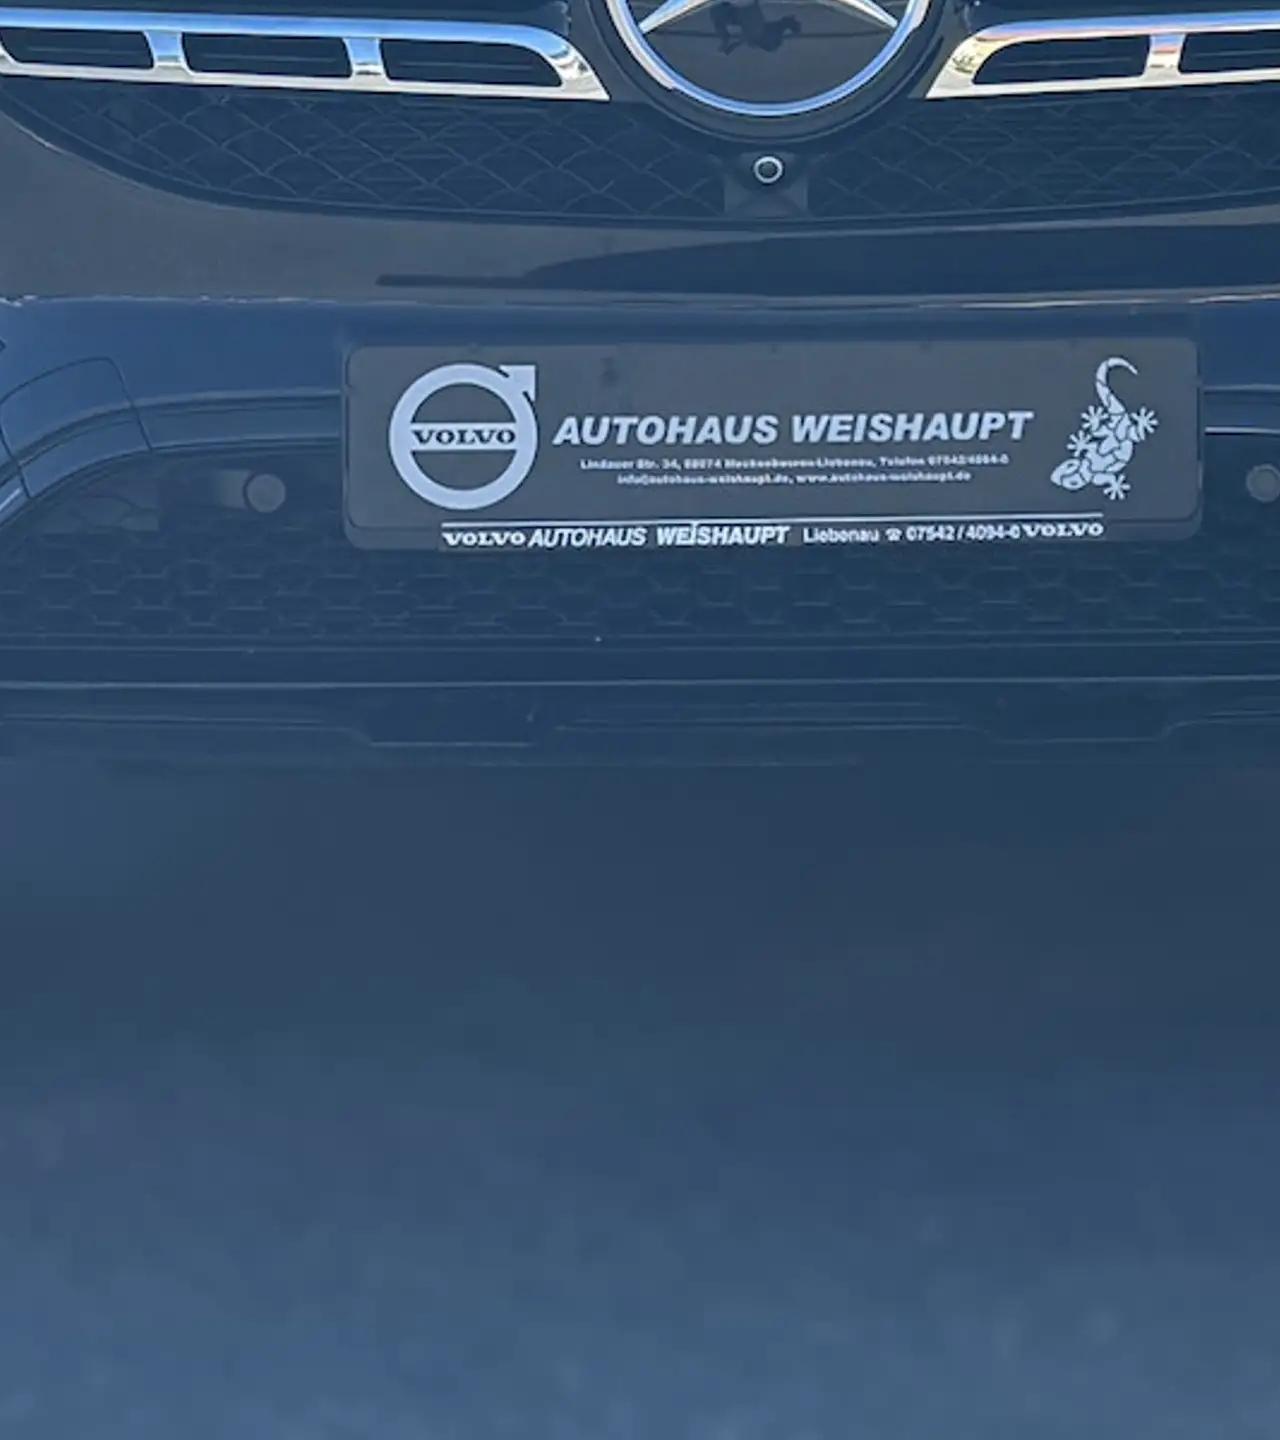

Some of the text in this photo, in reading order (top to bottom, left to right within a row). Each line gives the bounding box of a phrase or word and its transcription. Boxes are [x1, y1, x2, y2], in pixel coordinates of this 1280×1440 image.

[411, 428, 517, 446] VOLVO
[552, 410, 1035, 446] AUTOHAUS WEISHAUPT
[441, 531, 526, 547] VOLVO
[527, 527, 649, 548] AUTOHAUS
[655, 523, 790, 546] WEISHAUPT
[803, 526, 880, 543] Liebenau
[1022, 522, 1104, 538] VOLVO
